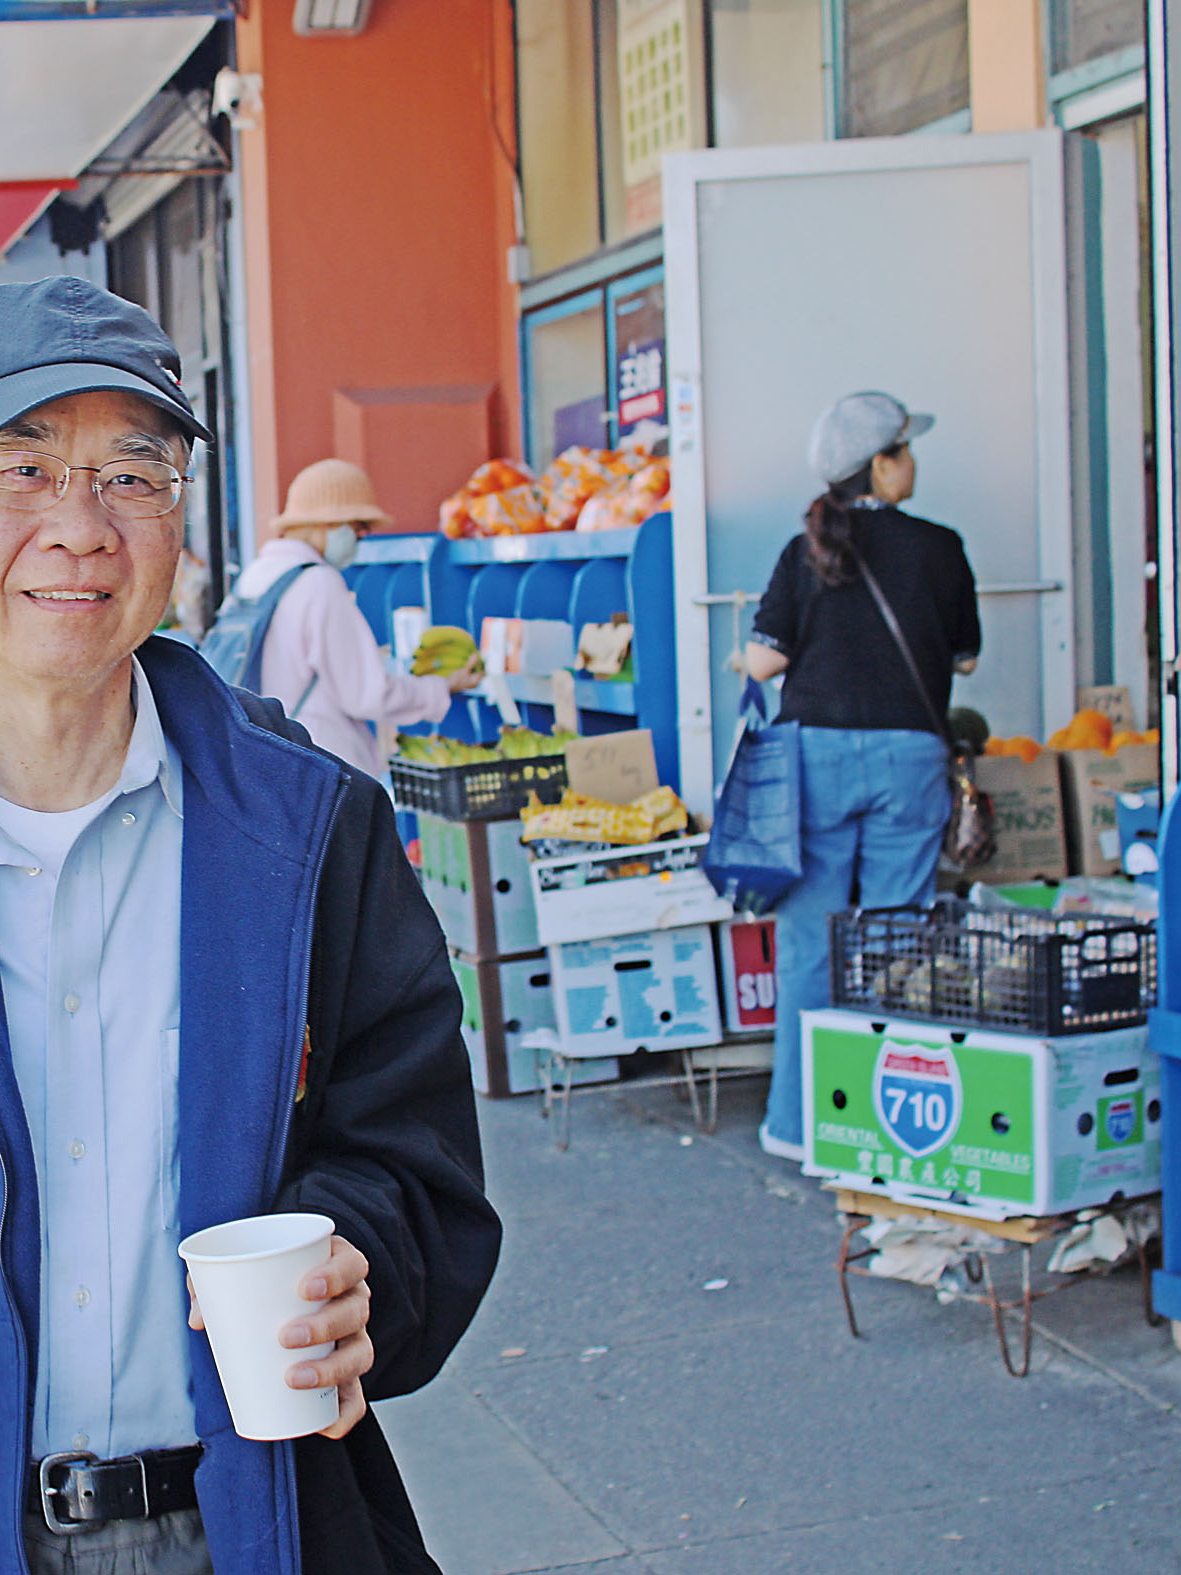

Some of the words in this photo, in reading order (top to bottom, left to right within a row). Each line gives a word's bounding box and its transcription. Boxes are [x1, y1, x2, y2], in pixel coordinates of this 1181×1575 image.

[738, 972, 776, 1011] SU
[885, 1087, 946, 1131] 710
[817, 1121, 883, 1149] ORIENTAL
[950, 1144, 1031, 1175] VEGETABLES
